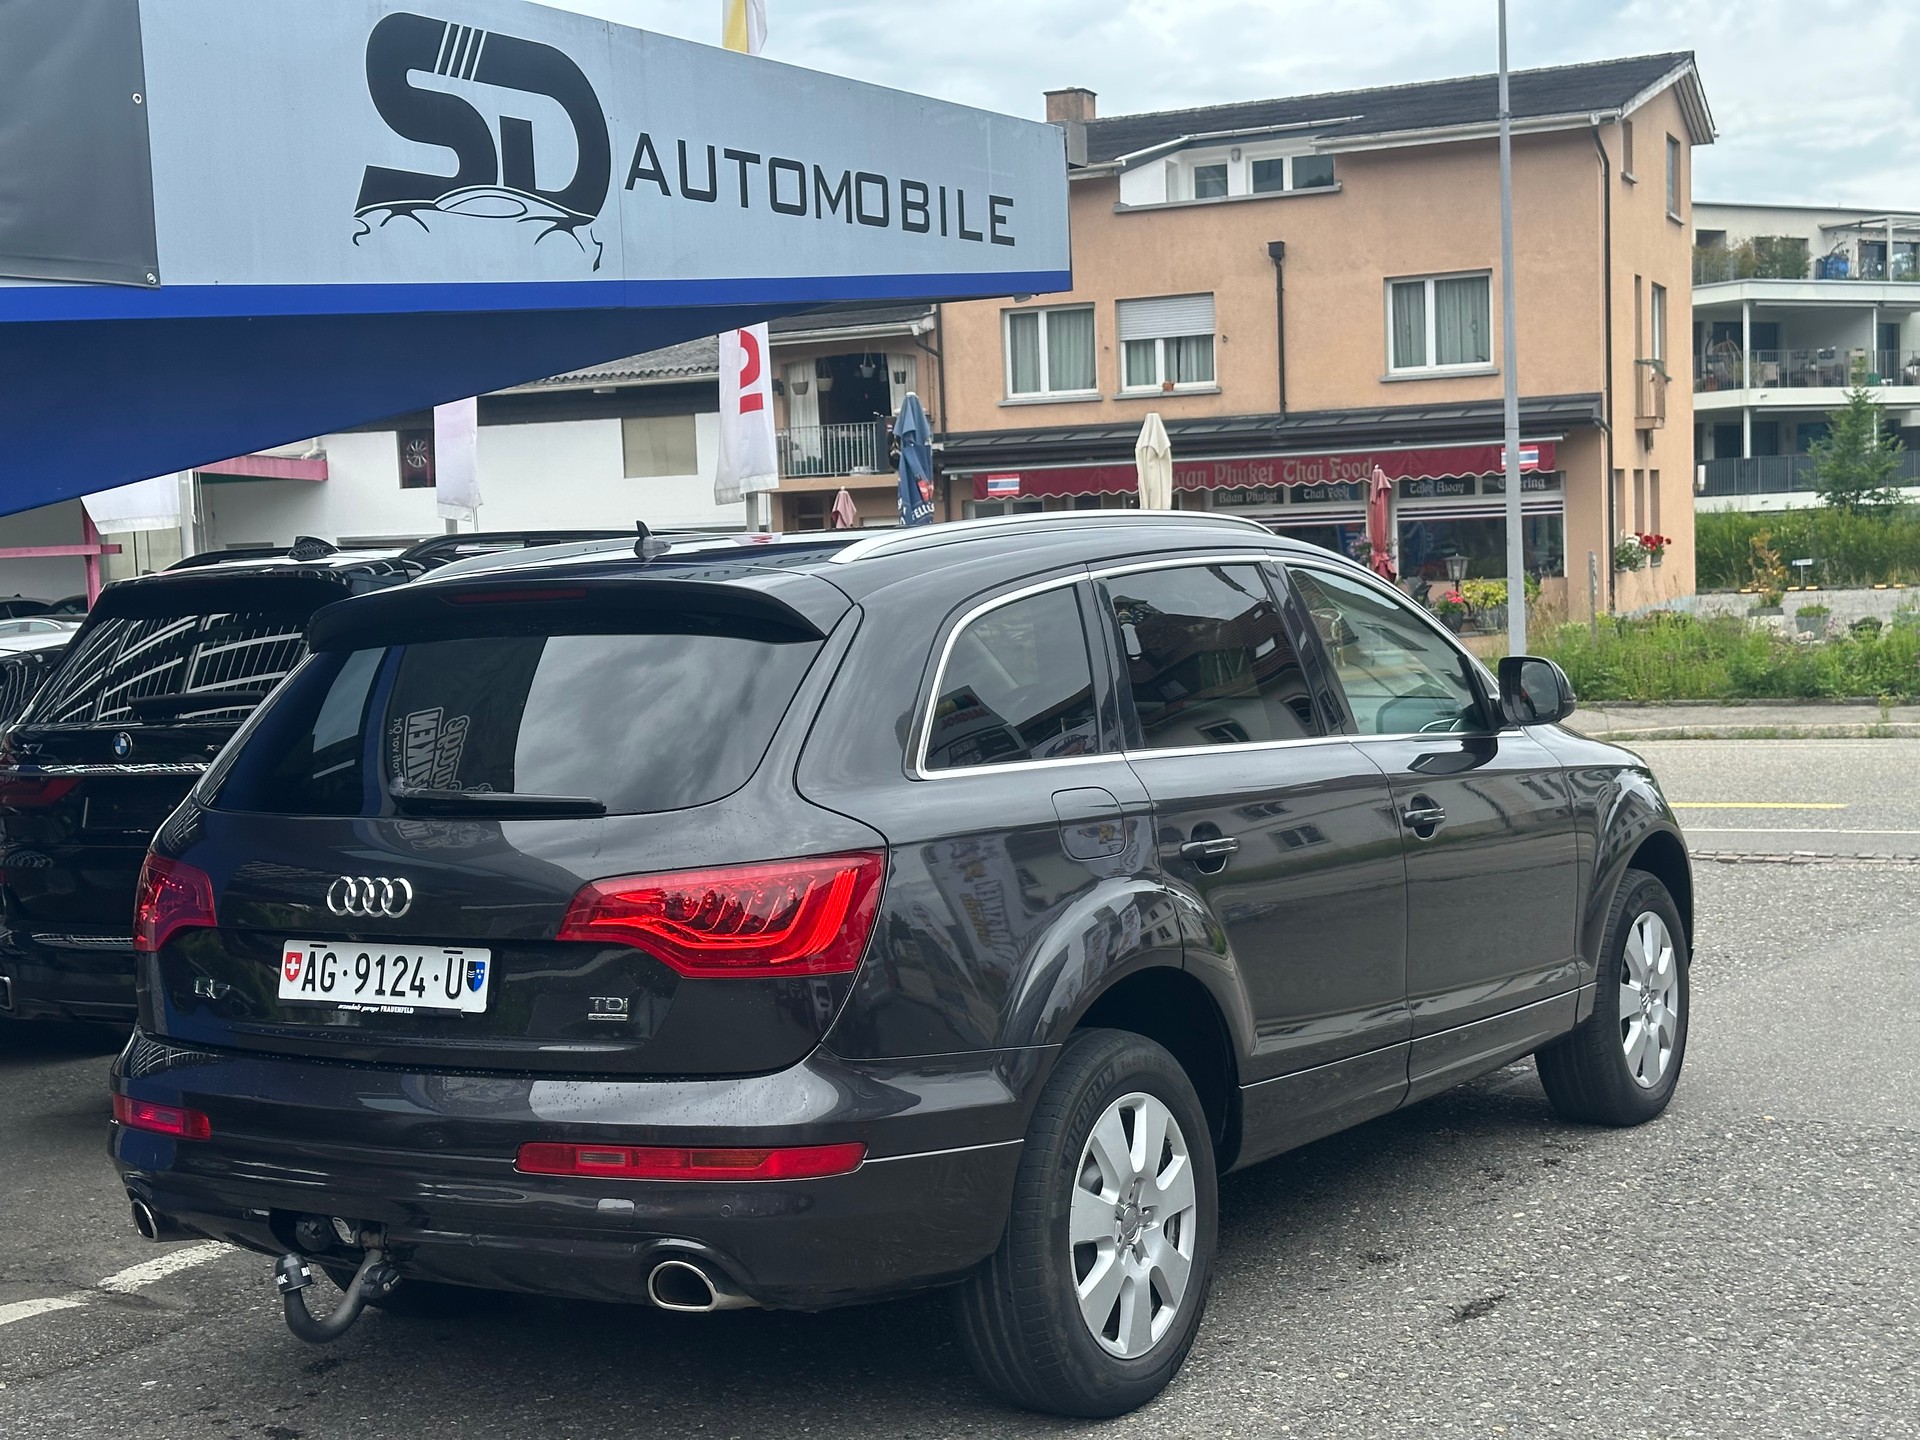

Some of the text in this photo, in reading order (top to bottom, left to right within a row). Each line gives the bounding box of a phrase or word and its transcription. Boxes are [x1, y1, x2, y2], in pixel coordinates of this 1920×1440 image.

[355, 12, 1015, 246] SD AUTOMOBILE
[1173, 457, 1372, 487] aan Phuket Thai Food
[1303, 485, 1351, 500] Thai Food
[1437, 481, 1465, 493] Away
[1246, 491, 1277, 502] Phuket
